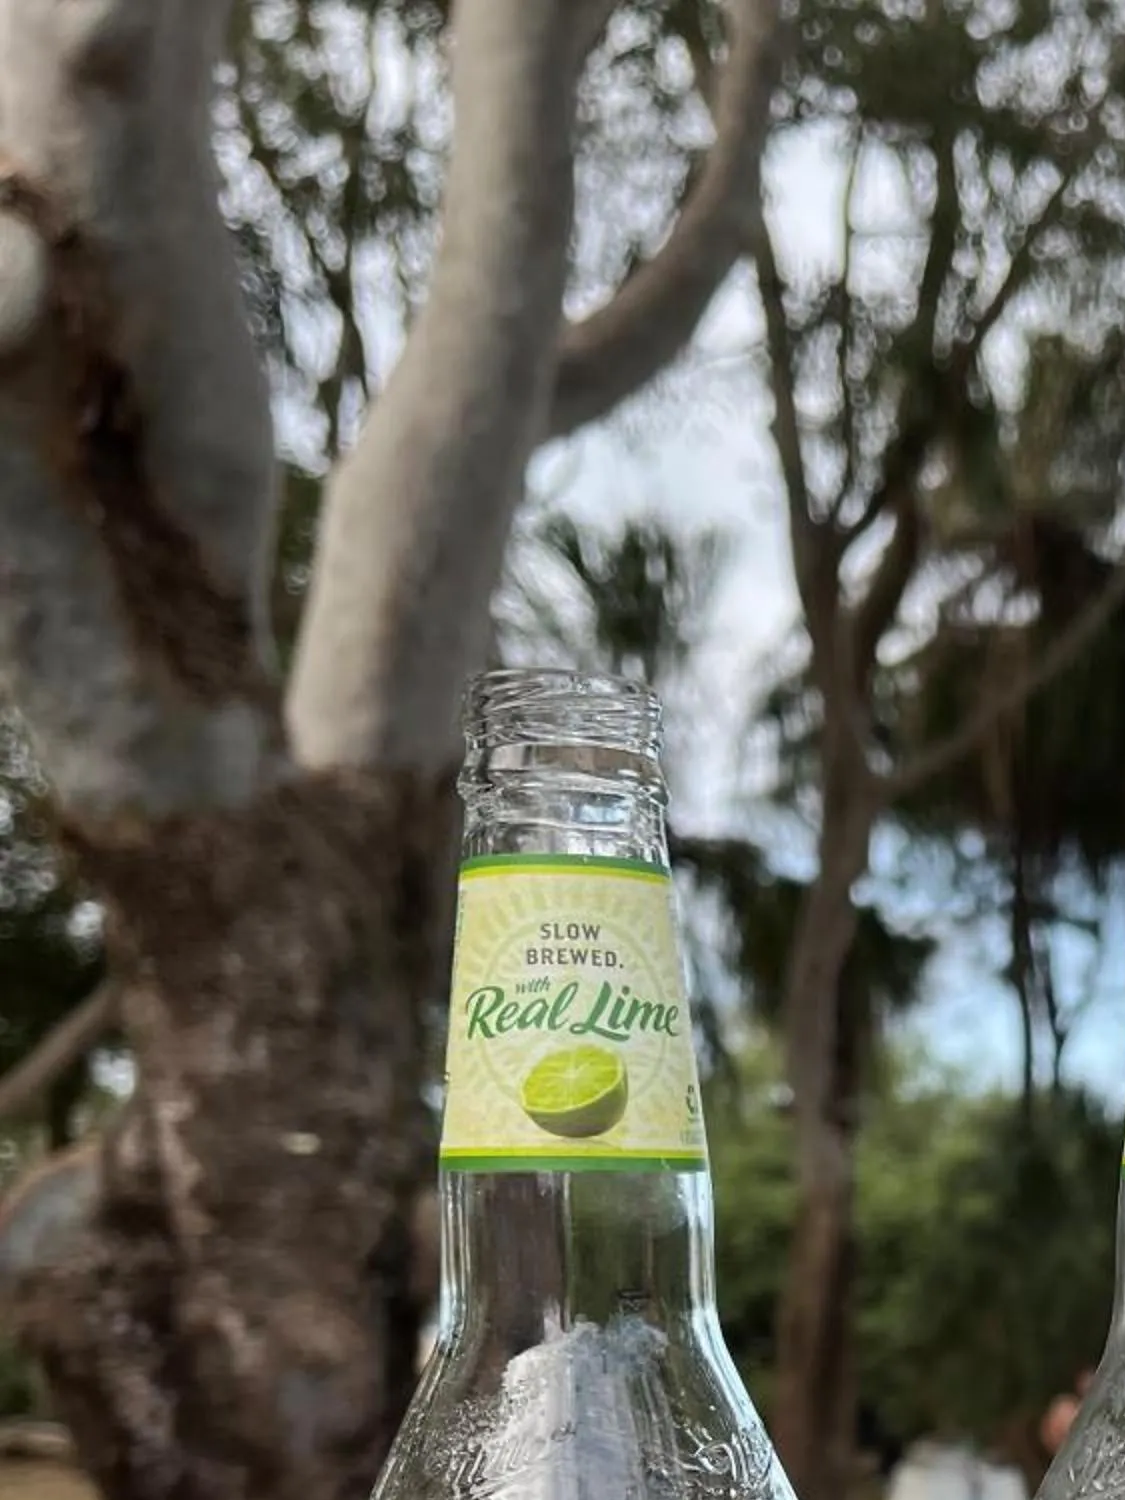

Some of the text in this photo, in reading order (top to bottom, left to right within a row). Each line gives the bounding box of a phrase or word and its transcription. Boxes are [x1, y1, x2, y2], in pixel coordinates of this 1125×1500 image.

[540, 923, 600, 940] SLOW
[515, 976, 550, 994] with
[465, 980, 679, 1041] Real Lime
